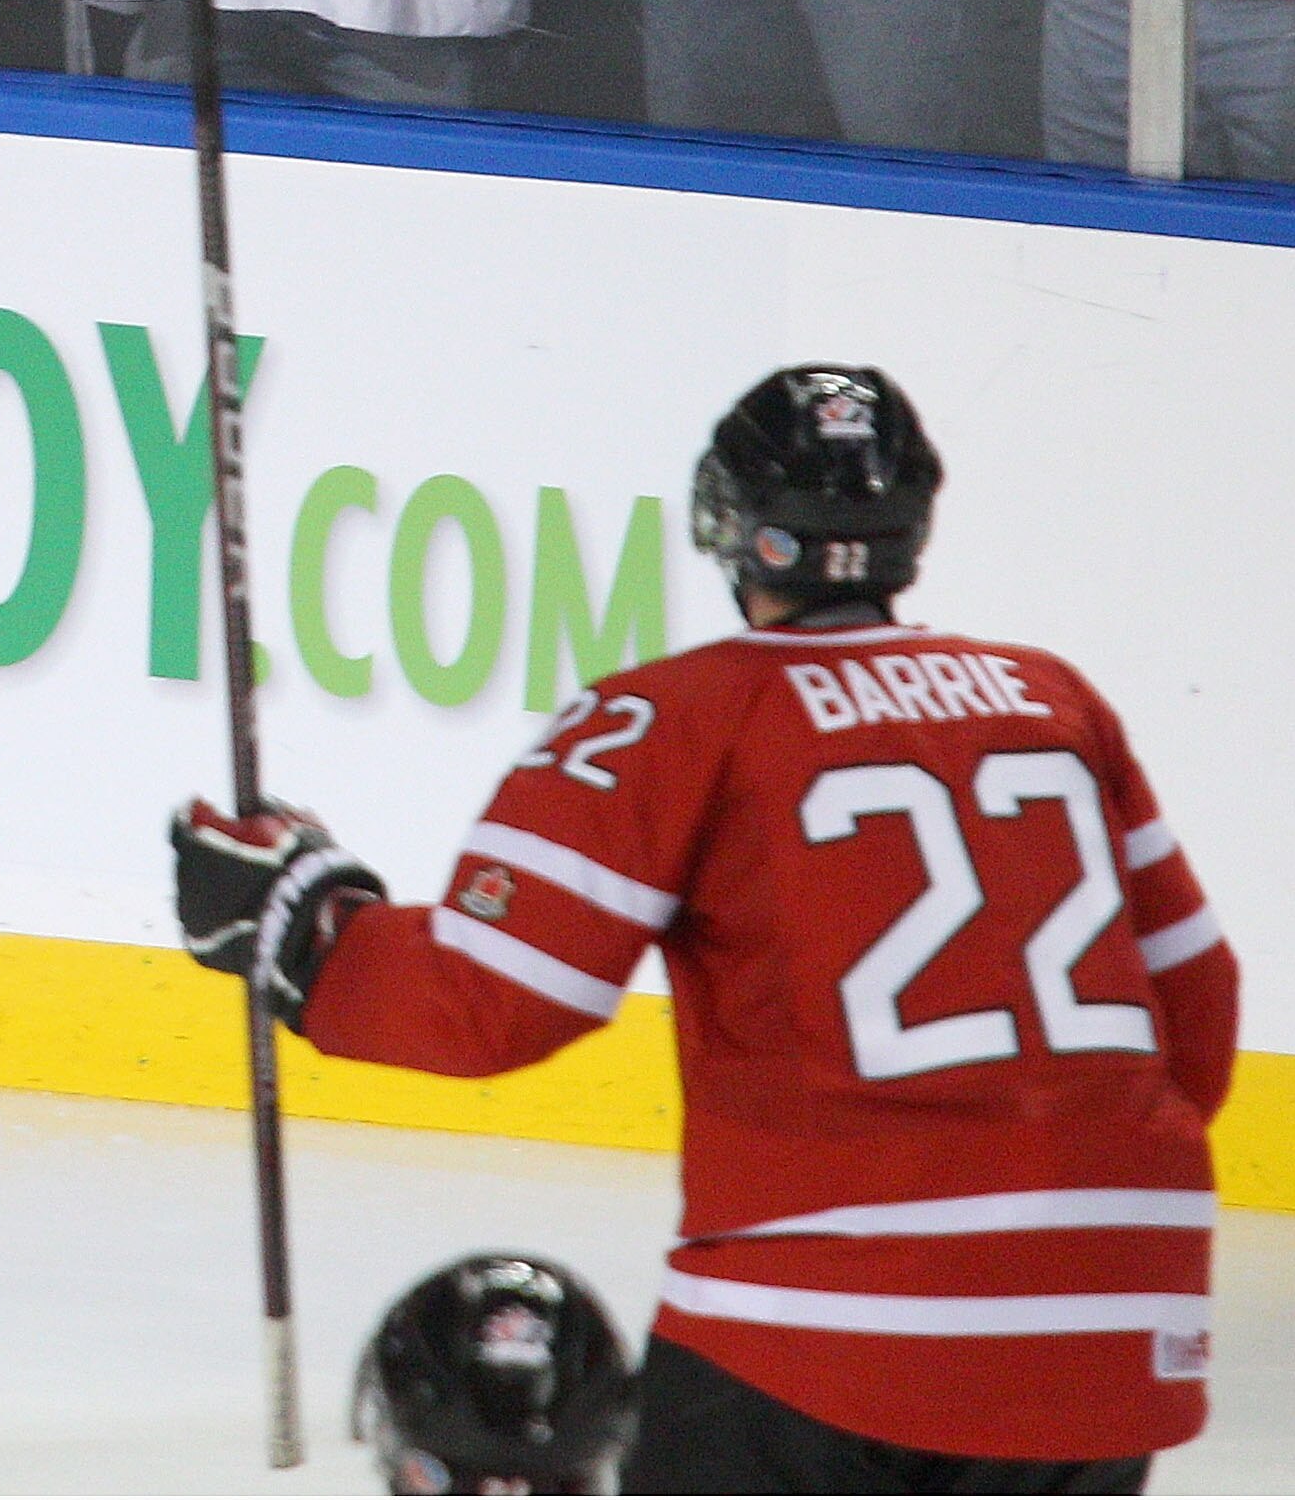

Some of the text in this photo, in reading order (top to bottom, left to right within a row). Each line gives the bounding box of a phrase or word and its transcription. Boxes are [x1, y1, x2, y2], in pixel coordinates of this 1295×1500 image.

[515, 688, 656, 790] 22
[783, 652, 1053, 734] BARRIE
[800, 749, 1159, 1081] 22
